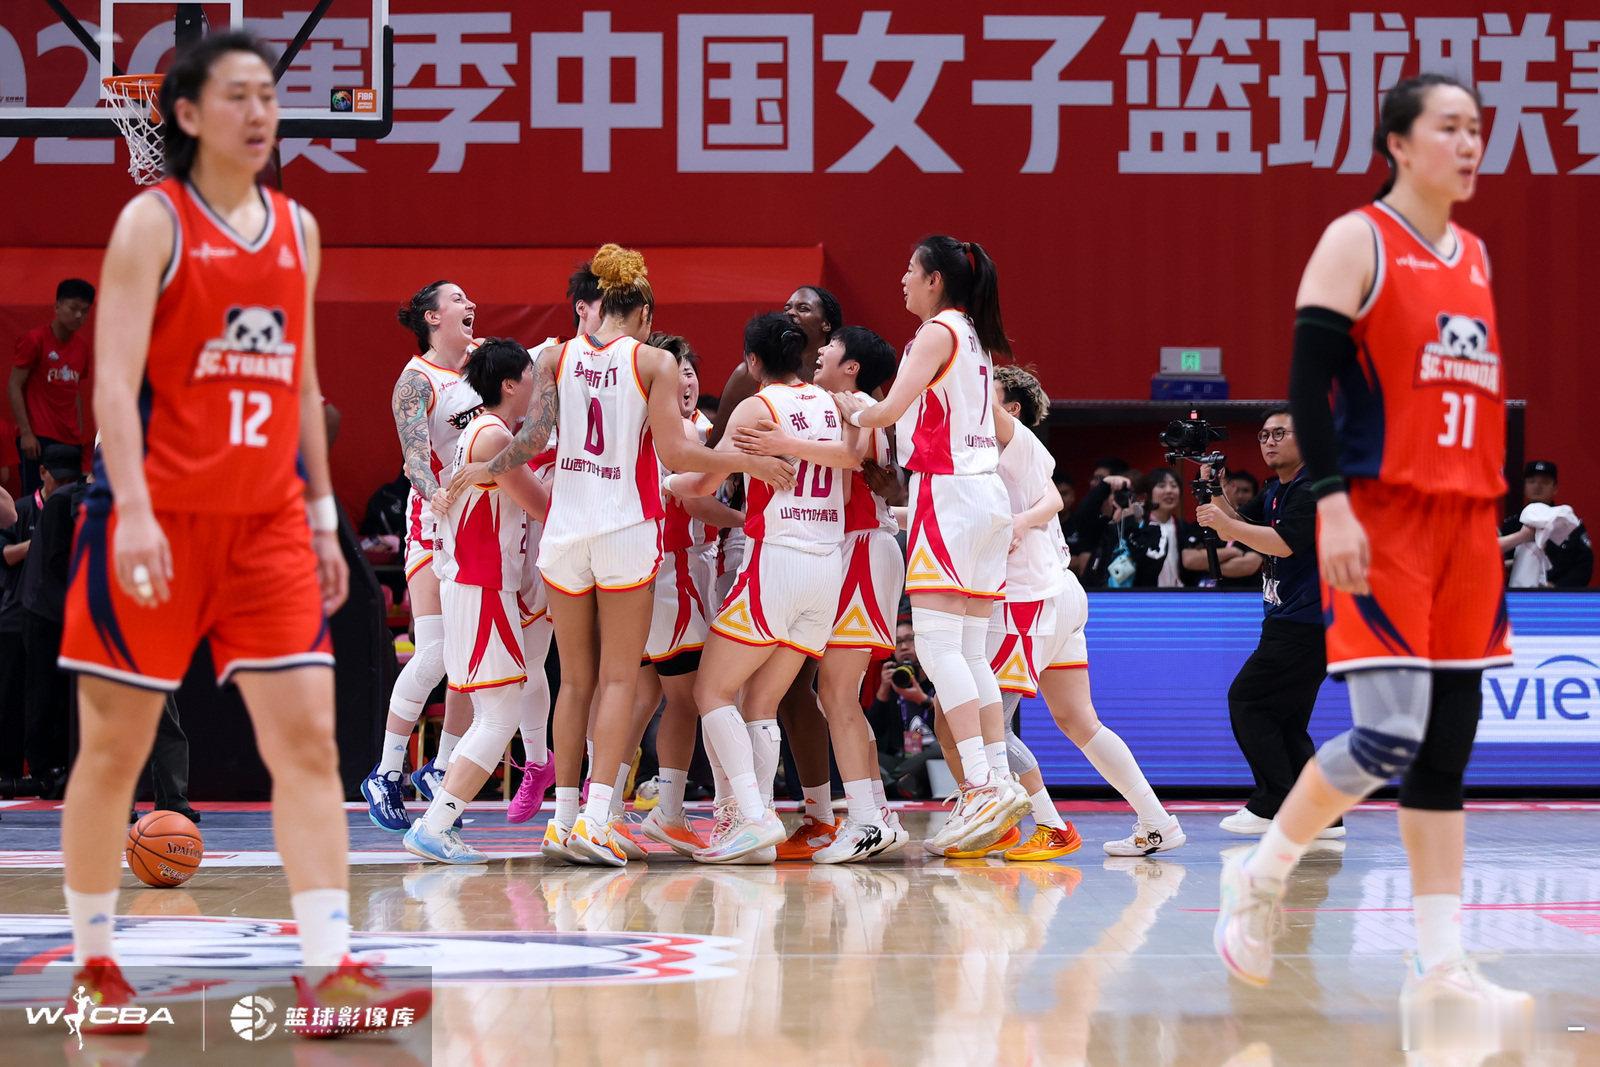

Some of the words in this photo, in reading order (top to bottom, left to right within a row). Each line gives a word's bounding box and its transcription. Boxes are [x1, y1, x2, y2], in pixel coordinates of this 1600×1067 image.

[357, 92, 374, 101] FIBA
[229, 389, 272, 447] 12
[584, 397, 605, 456] 0
[1437, 392, 1477, 449] 31
[780, 507, 838, 522] 山西竹叶青酒
[1479, 677, 1600, 720] vie
